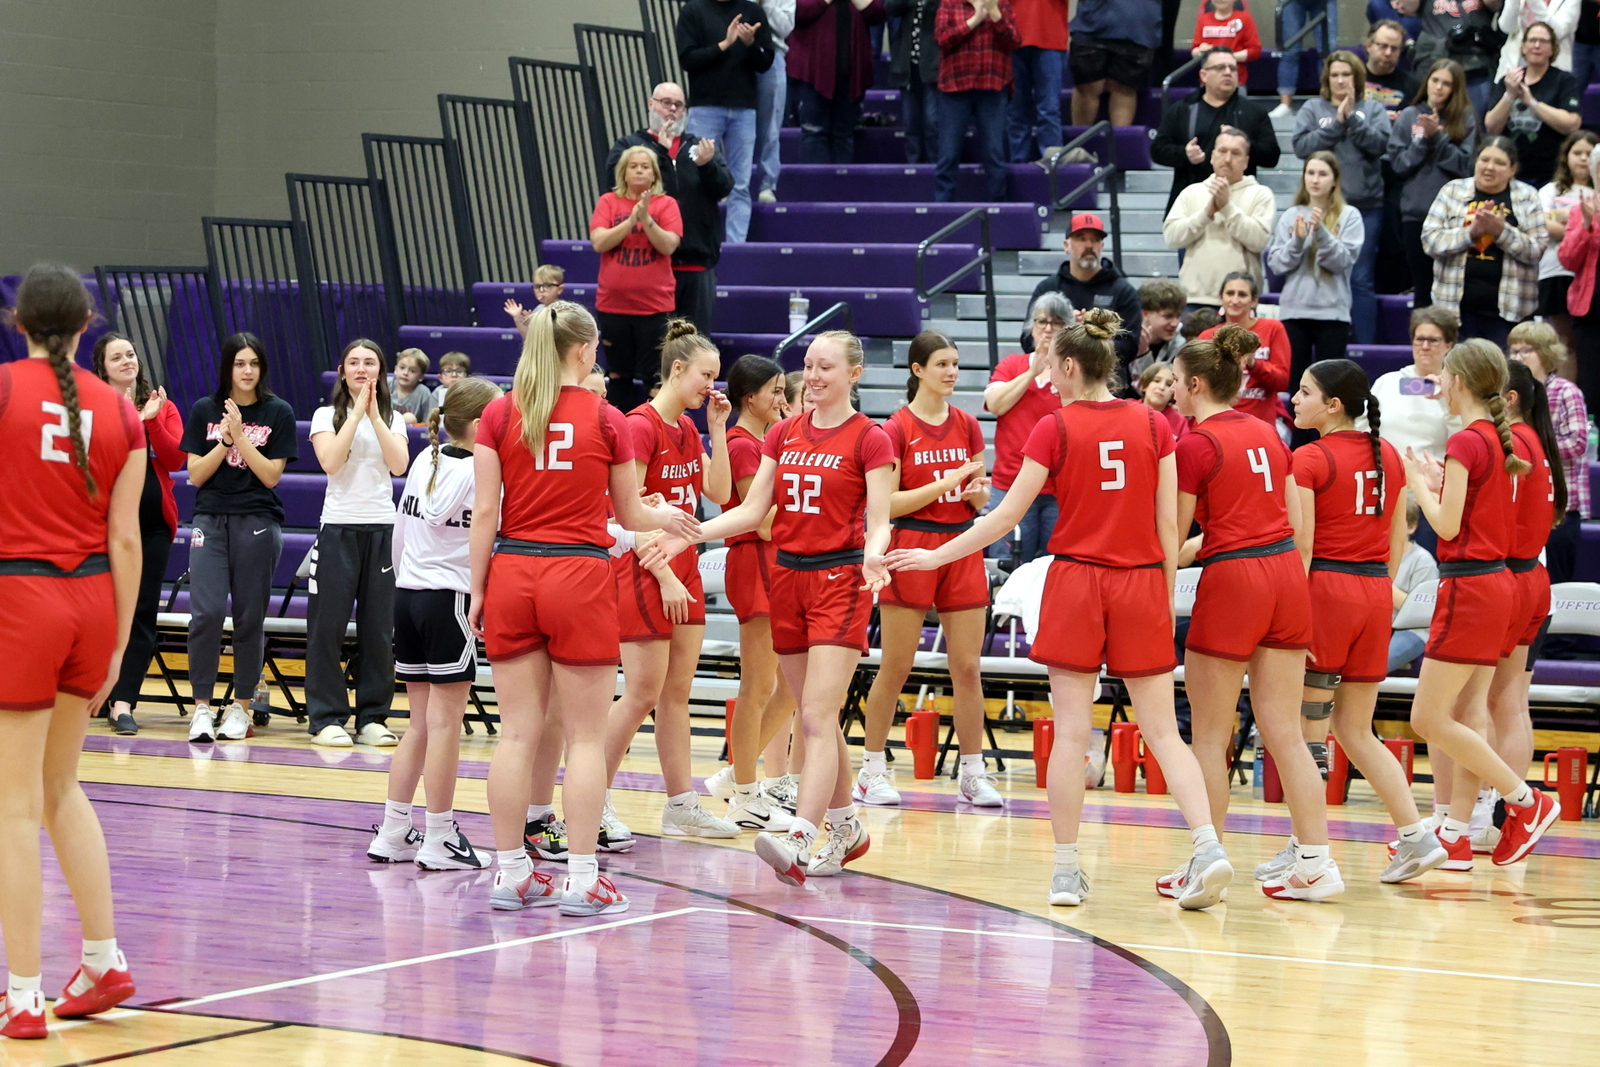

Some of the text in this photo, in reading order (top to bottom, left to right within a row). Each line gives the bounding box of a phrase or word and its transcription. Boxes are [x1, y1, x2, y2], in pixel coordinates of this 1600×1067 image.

[609, 246, 658, 267] INALS
[779, 451, 843, 469] BELLEVUE
[914, 447, 967, 466] BELLEVUE
[1099, 440, 1126, 491] 5
[1246, 447, 1274, 492] 4
[782, 472, 822, 514] 32
[1354, 469, 1386, 515] 13
